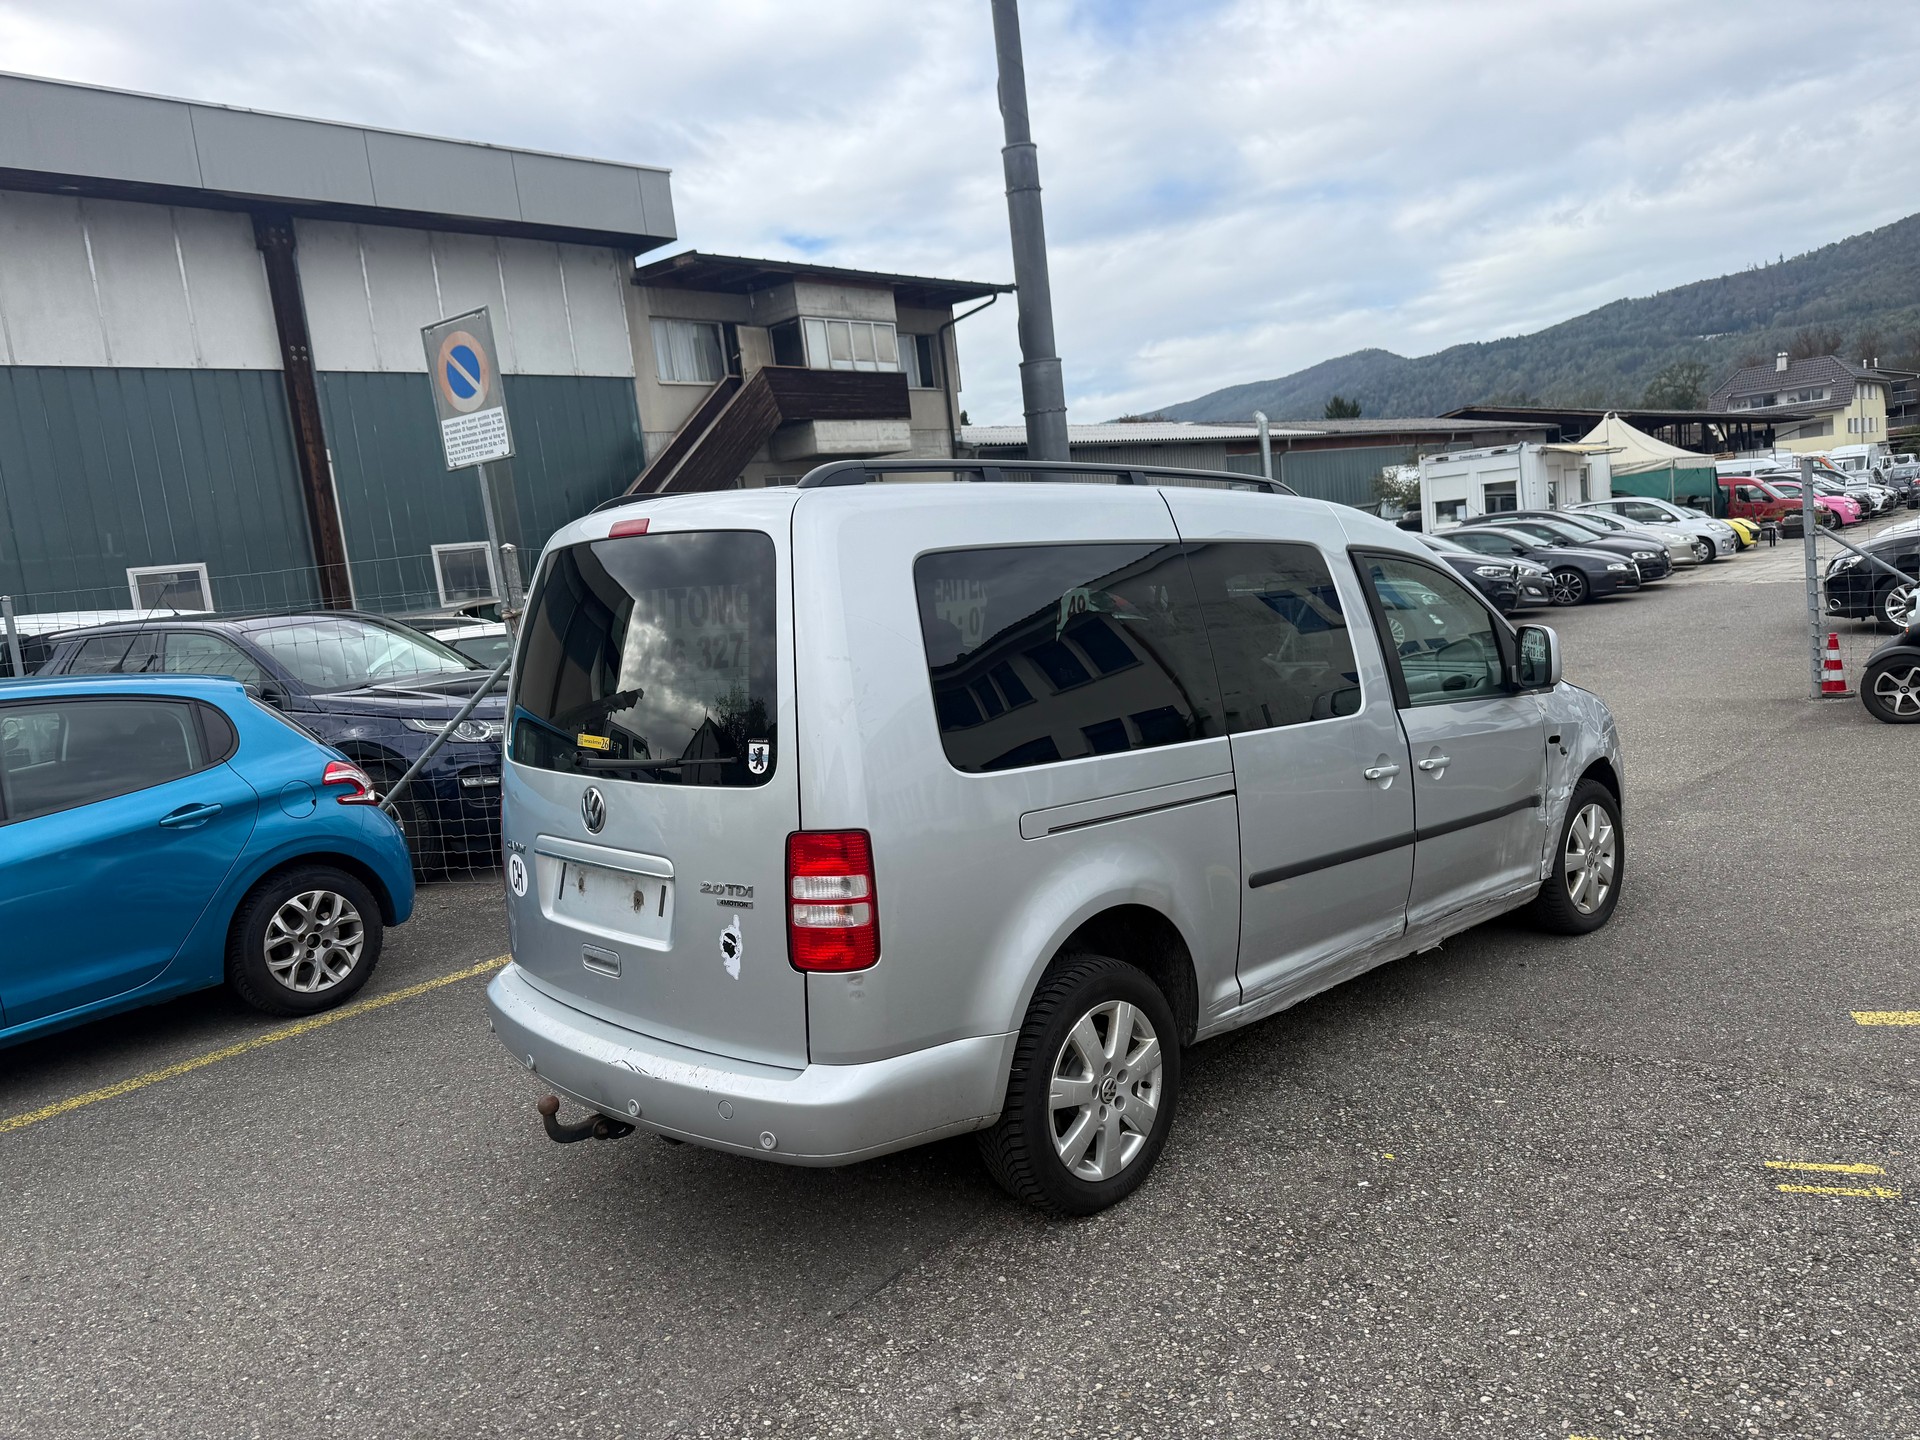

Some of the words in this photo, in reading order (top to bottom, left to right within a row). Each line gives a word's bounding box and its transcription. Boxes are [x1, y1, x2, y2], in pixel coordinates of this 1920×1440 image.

[601, 738, 609, 750] 26
[512, 859, 524, 892] CH
[700, 881, 725, 896] 2.0
[725, 882, 754, 898] TDI
[719, 898, 749, 909] 4MOTION
